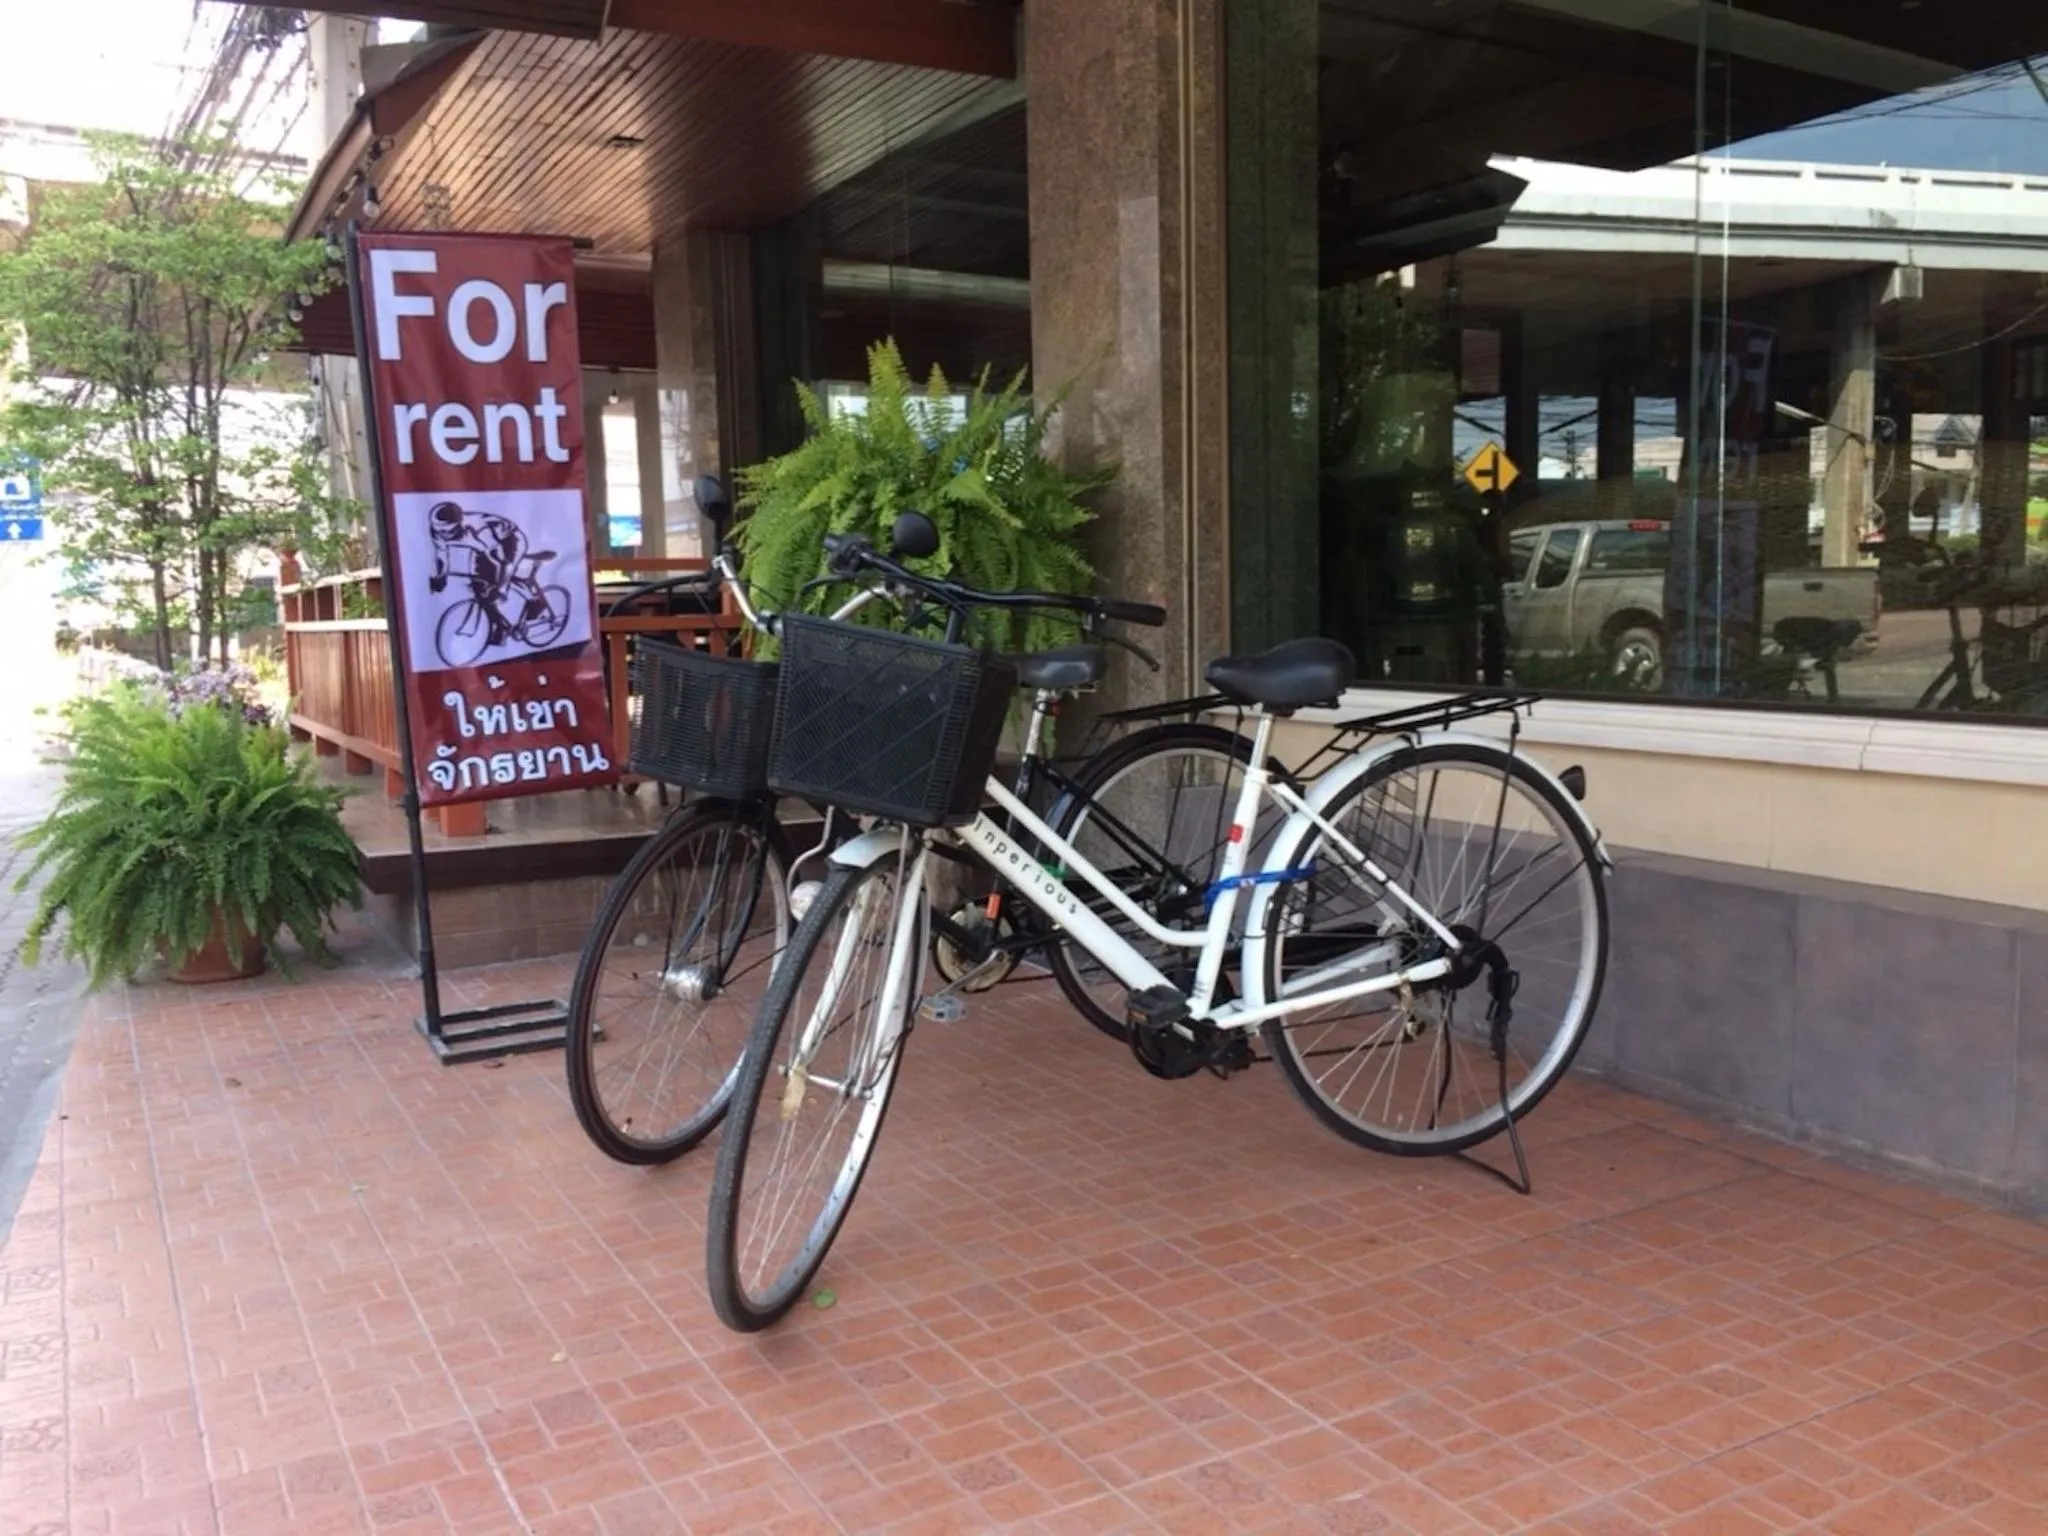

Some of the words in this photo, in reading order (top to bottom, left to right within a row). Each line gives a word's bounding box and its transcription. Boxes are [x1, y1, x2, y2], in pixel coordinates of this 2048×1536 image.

[369, 249, 567, 364] For
[393, 387, 570, 465] rent
[443, 674, 578, 738] ให้เช่า
[427, 743, 610, 791] จักรยาน
